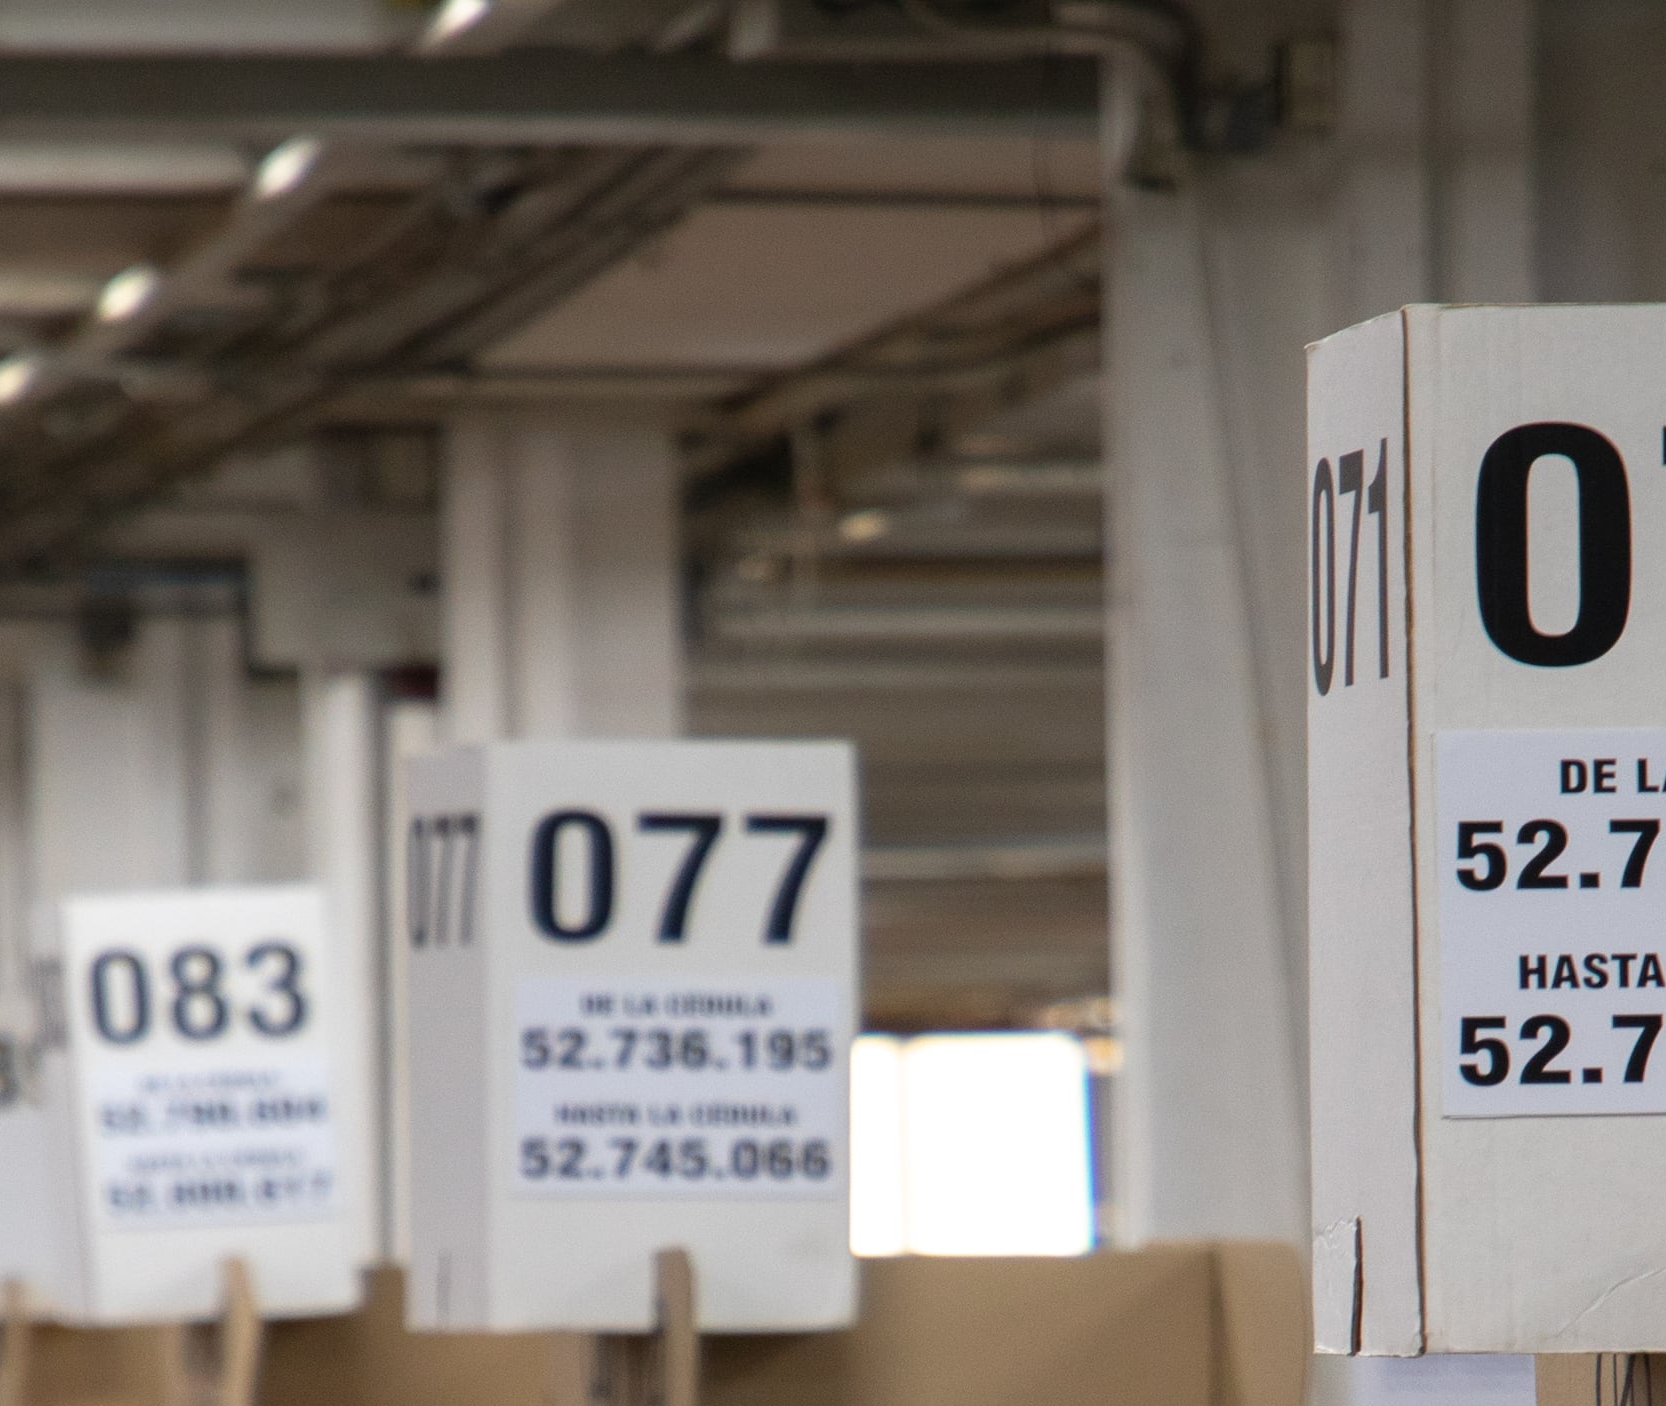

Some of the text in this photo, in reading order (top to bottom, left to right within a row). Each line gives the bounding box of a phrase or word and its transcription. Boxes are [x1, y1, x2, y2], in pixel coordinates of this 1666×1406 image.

[1311, 437, 1391, 697] 071
[1560, 758, 1617, 795] DE
[409, 810, 481, 949] 077
[528, 808, 831, 946] 077
[87, 940, 310, 1047] 083
[1518, 953, 1666, 990] HASTA
[522, 1027, 833, 1072] 52.736.195
[522, 1136, 833, 1181] 52.745.066
